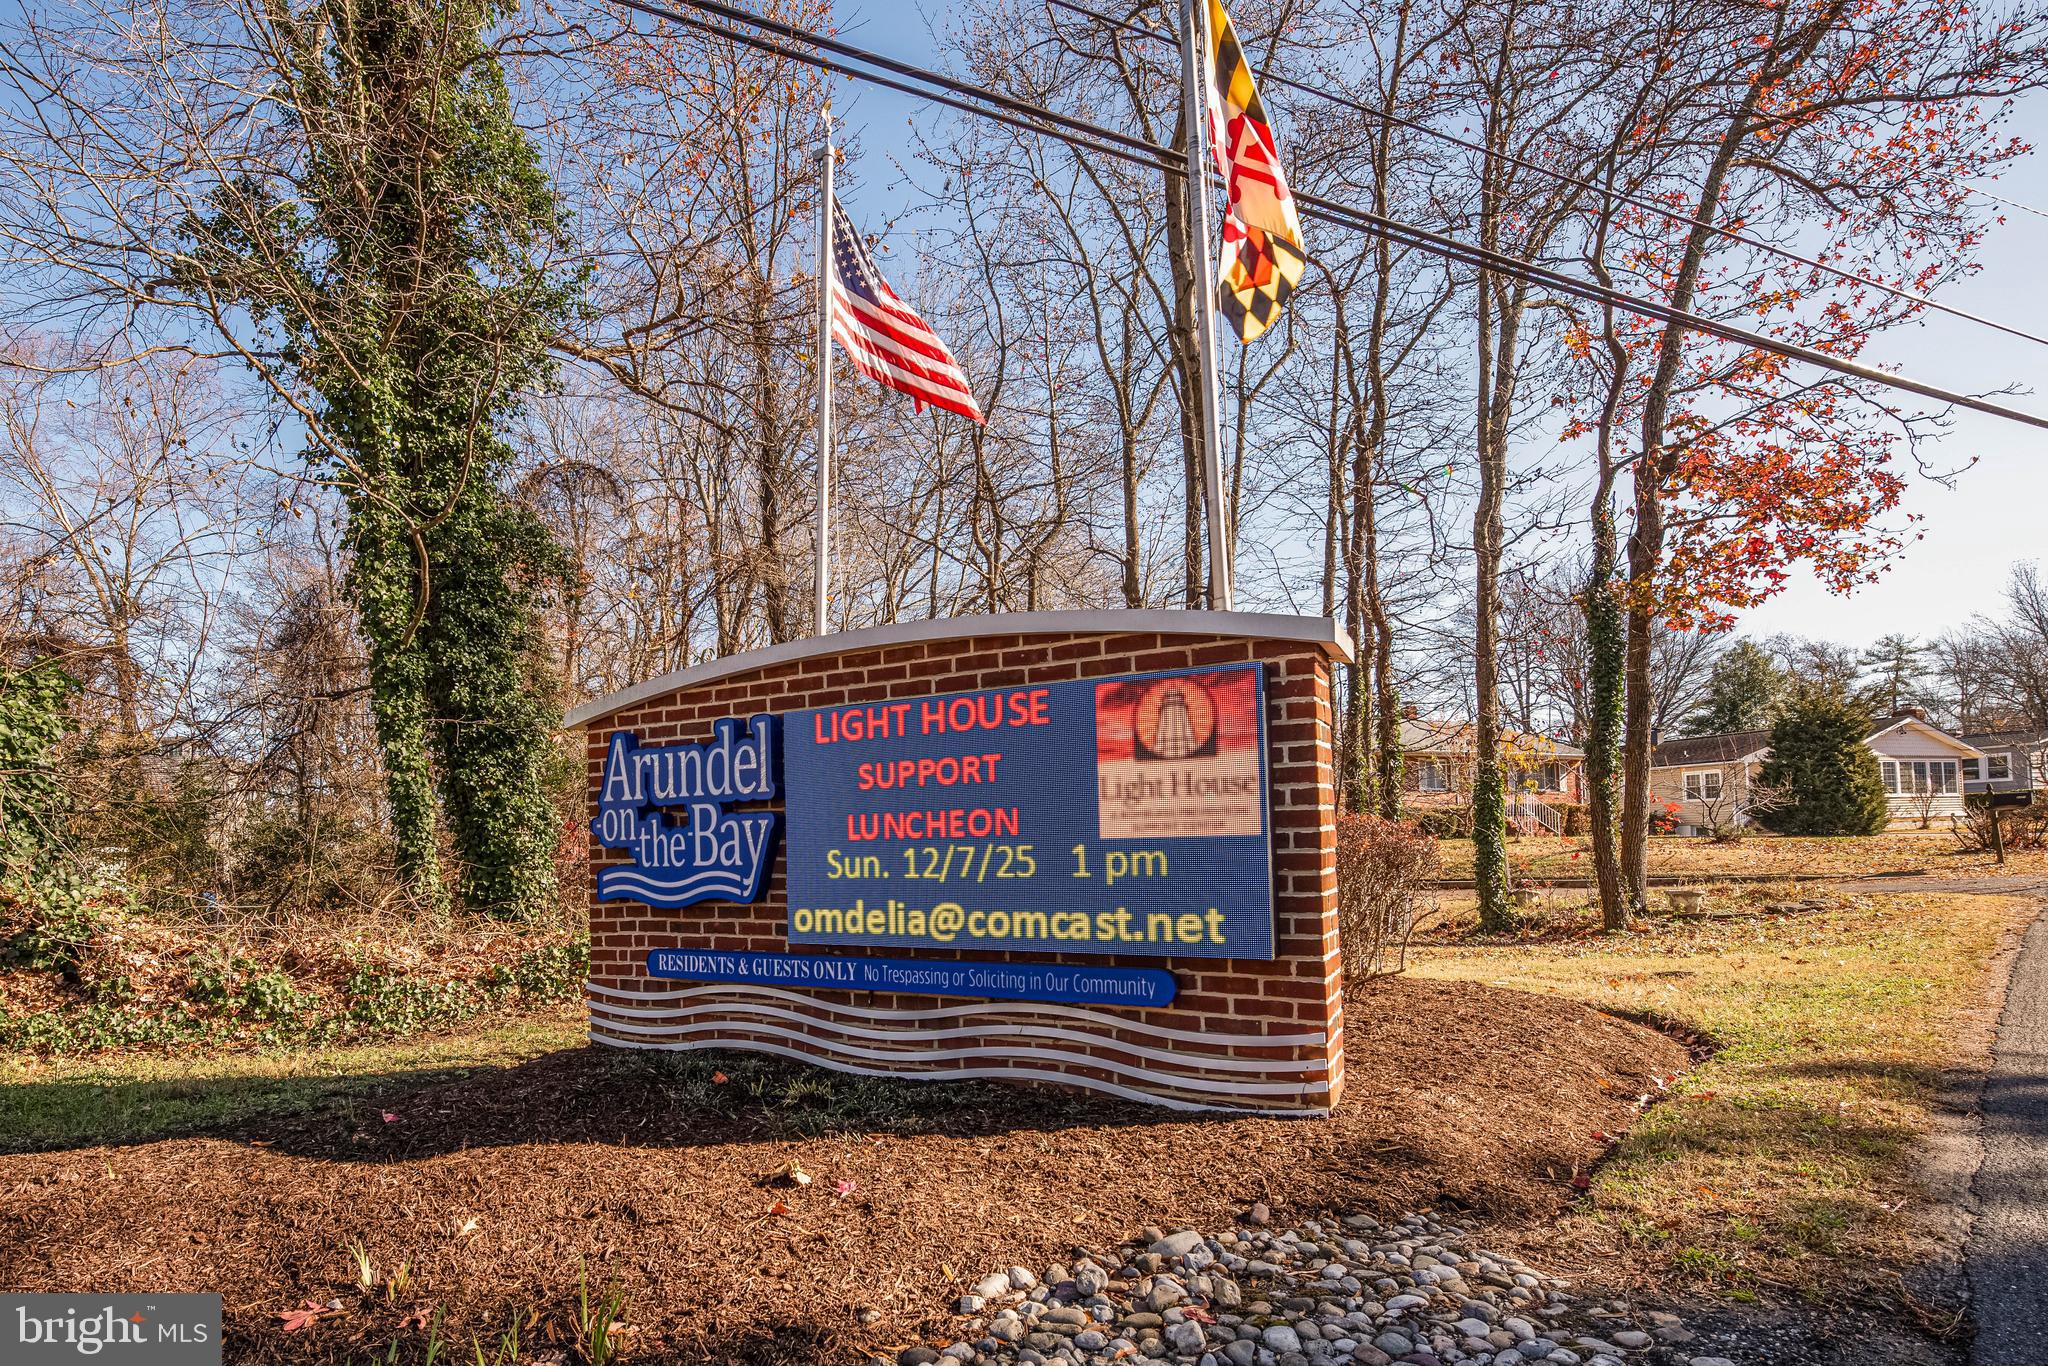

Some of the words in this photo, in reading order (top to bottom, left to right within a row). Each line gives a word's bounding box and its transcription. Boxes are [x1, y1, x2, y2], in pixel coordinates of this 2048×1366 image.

[814, 704, 911, 744] LIGHT
[921, 689, 1049, 735] HOUSE
[603, 721, 770, 802] Arundel
[857, 753, 1002, 790] SUPPORT
[1099, 772, 1164, 807] Light
[1171, 770, 1257, 797] House
[847, 807, 1020, 841] LUNCHEON
[827, 849, 889, 879] Sun.
[902, 844, 1036, 883] 12/7/25
[1072, 844, 1092, 878] 1
[1106, 849, 1169, 886] pm
[793, 899, 1227, 945] omdelia@comcast.net
[658, 953, 735, 975] RESIDENTS
[738, 958, 749, 975] &
[752, 958, 810, 979] GUESTS
[813, 960, 857, 981] ONLY
[864, 964, 879, 982] No
[883, 965, 949, 988] Trespassing
[952, 972, 965, 986] or
[969, 968, 1025, 993] Soliciting
[1029, 971, 1041, 990] in
[1046, 972, 1069, 992] Our
[1073, 973, 1156, 999] Community
